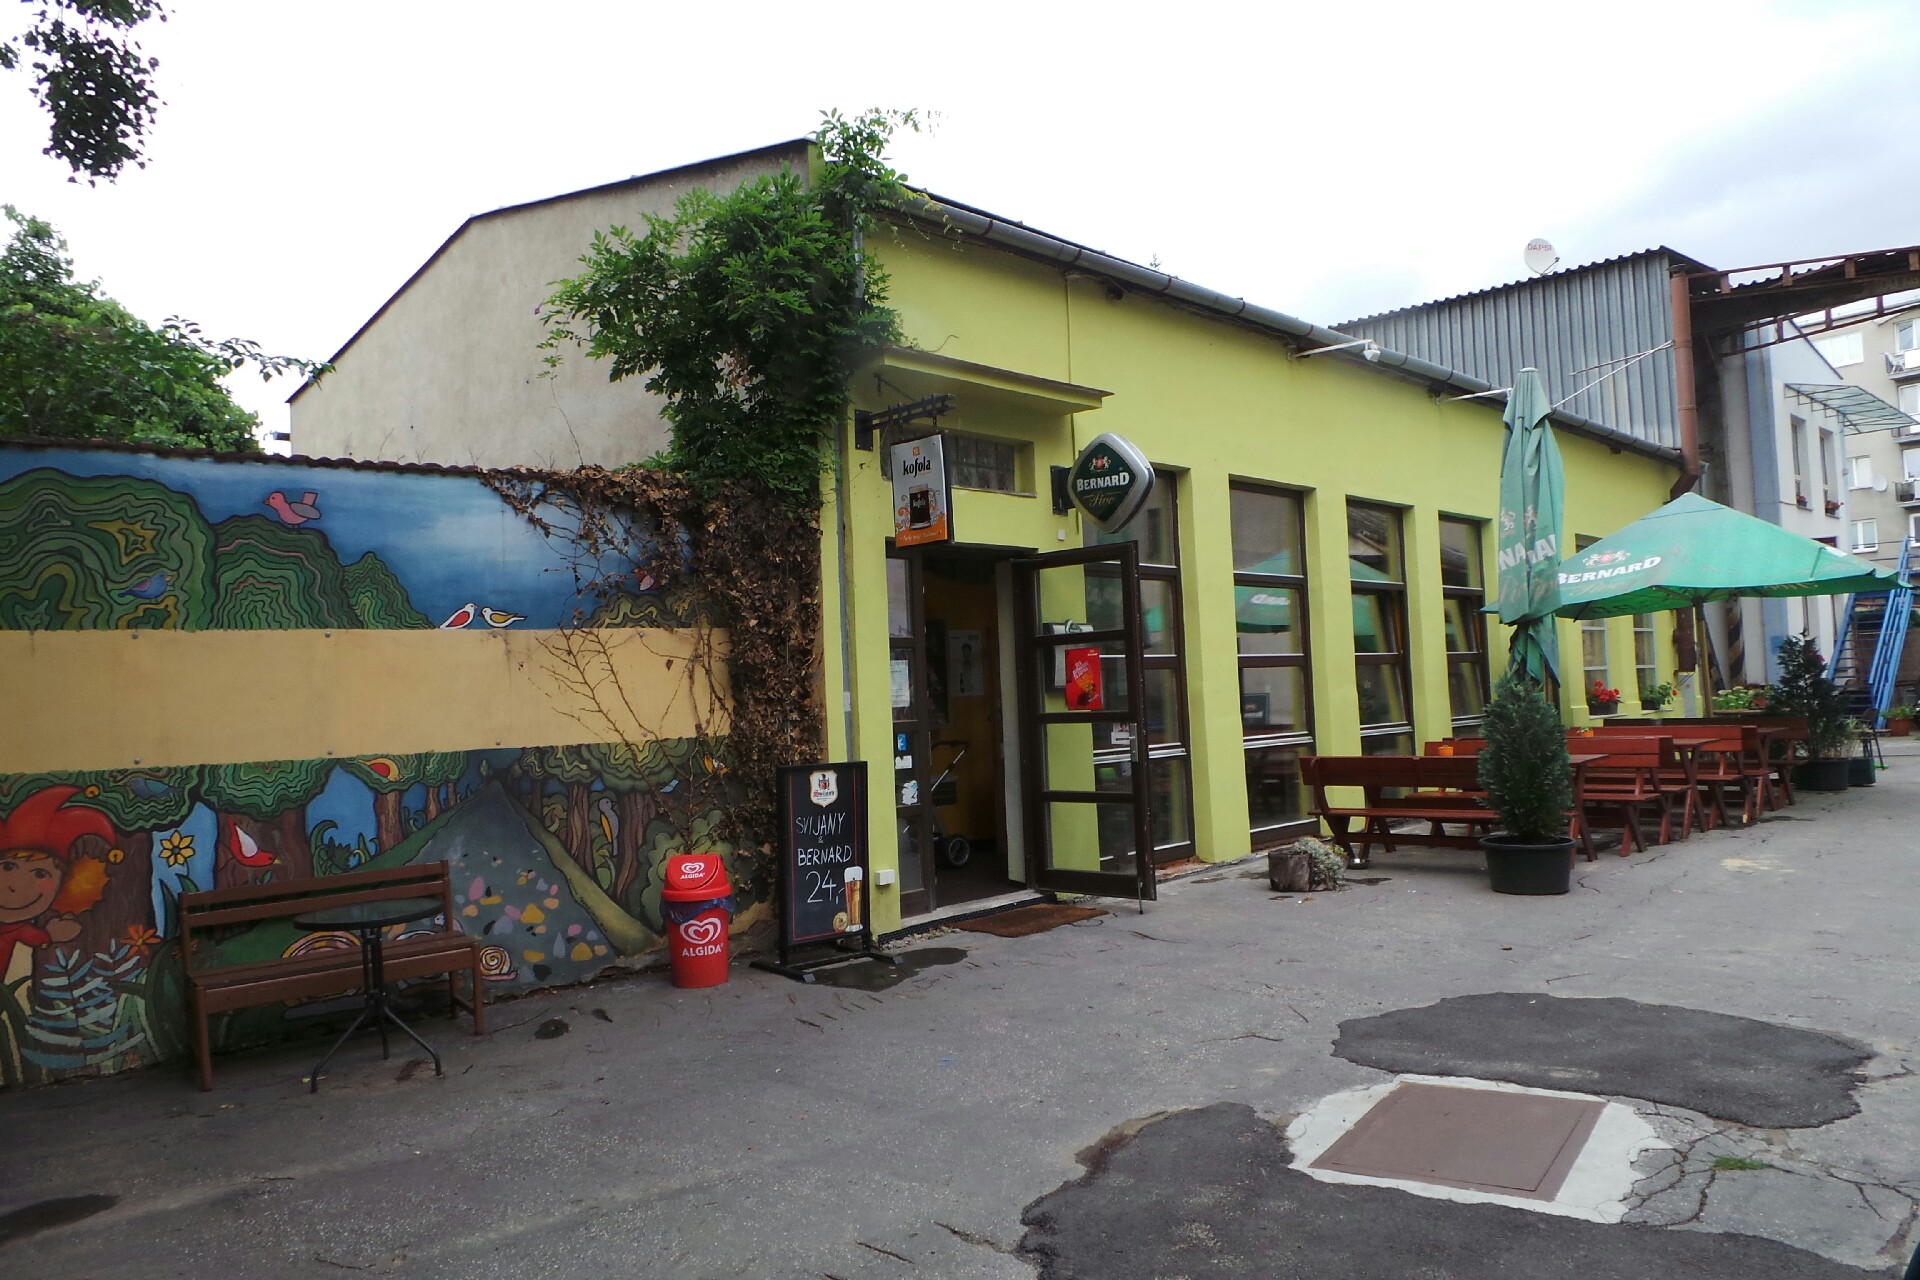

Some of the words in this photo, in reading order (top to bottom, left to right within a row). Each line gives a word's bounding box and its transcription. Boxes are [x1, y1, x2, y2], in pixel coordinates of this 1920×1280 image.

[903, 457, 931, 478] kofola
[1076, 471, 1130, 491] BERNARD
[1557, 556, 1662, 585] BERNARD
[796, 812, 846, 836] SVIJANY
[817, 835, 824, 844] &
[797, 845, 852, 867] BERNARD
[682, 944, 722, 957] ALGIDA
